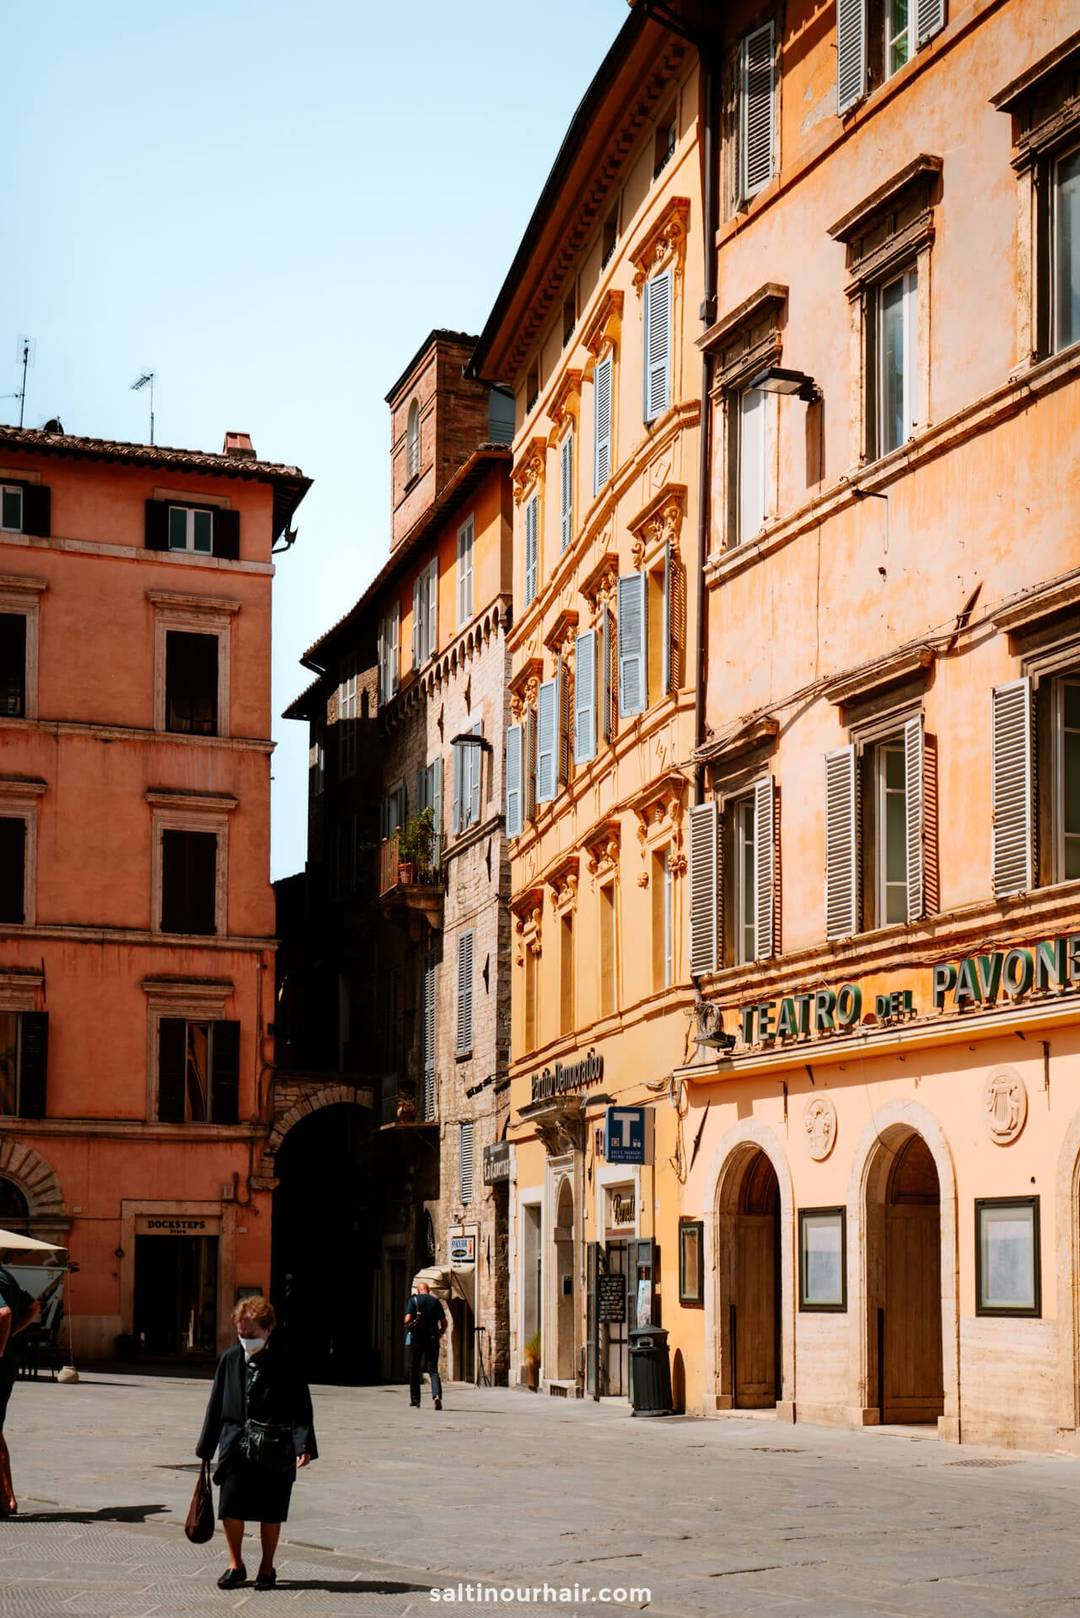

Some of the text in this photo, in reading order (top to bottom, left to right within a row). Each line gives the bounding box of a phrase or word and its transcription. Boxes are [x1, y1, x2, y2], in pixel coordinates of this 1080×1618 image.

[739, 933, 1080, 1043] TEATRO DEL PAVONE
[613, 1112, 640, 1147] T
[148, 1220, 205, 1229] DOCKSTEPS
